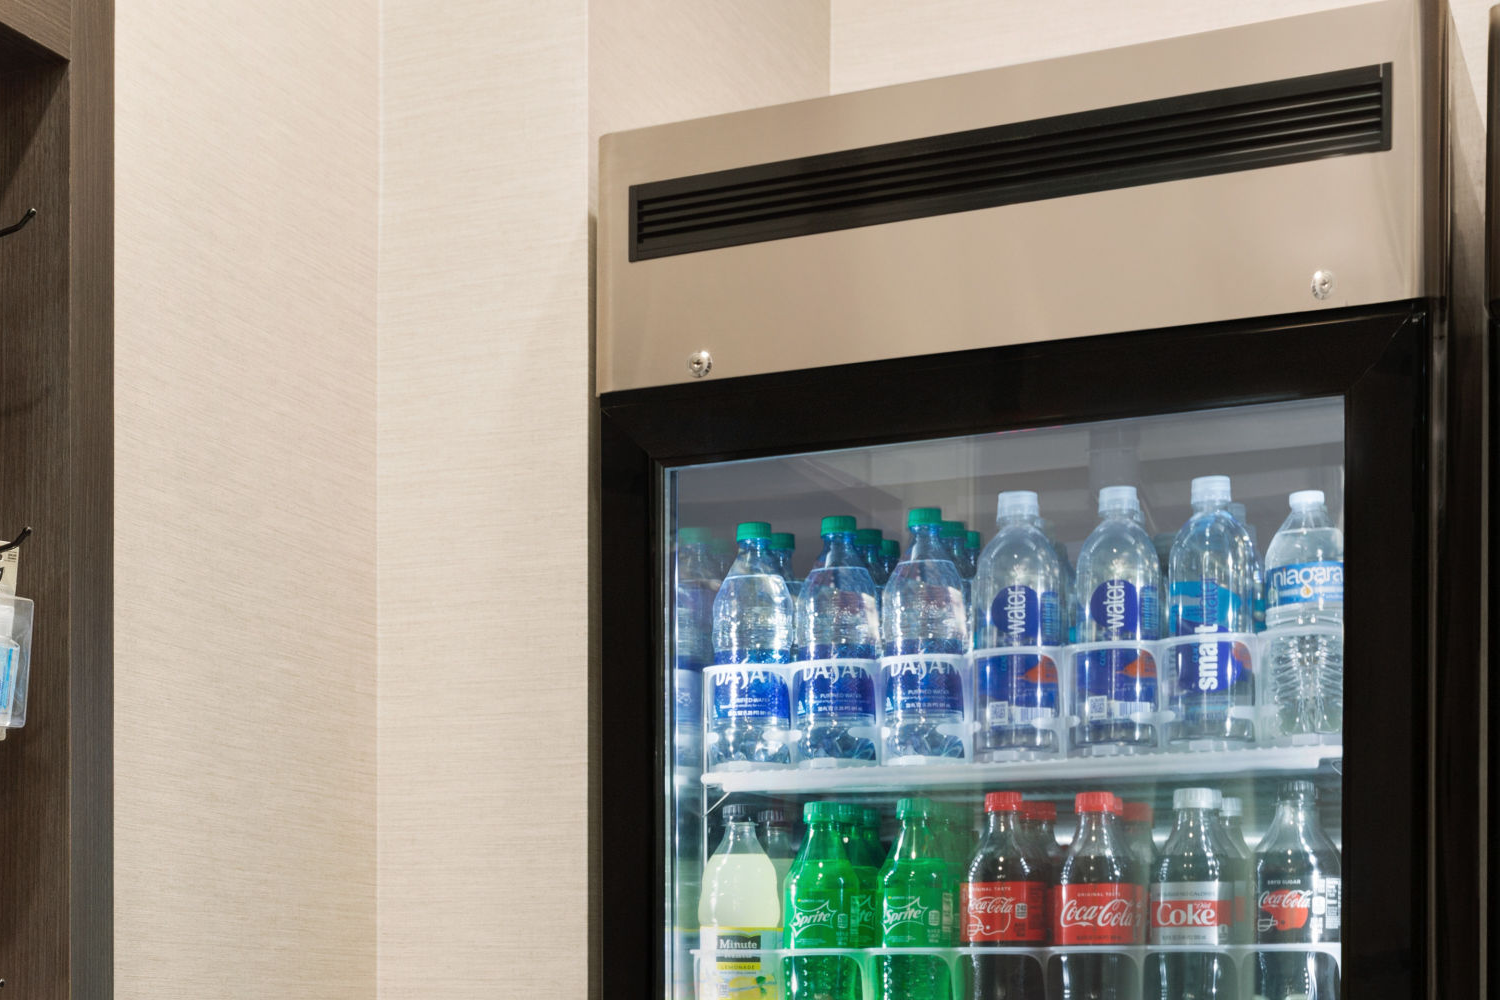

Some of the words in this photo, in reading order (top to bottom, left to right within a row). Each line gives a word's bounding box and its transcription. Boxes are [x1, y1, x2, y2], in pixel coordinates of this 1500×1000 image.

[1272, 566, 1343, 595] niagara
[1005, 587, 1026, 634] water
[1108, 581, 1124, 631] water
[794, 911, 831, 926] Sprite
[886, 909, 922, 924] Sprite
[1157, 902, 1216, 926] Coke
[720, 939, 757, 949] Minute
